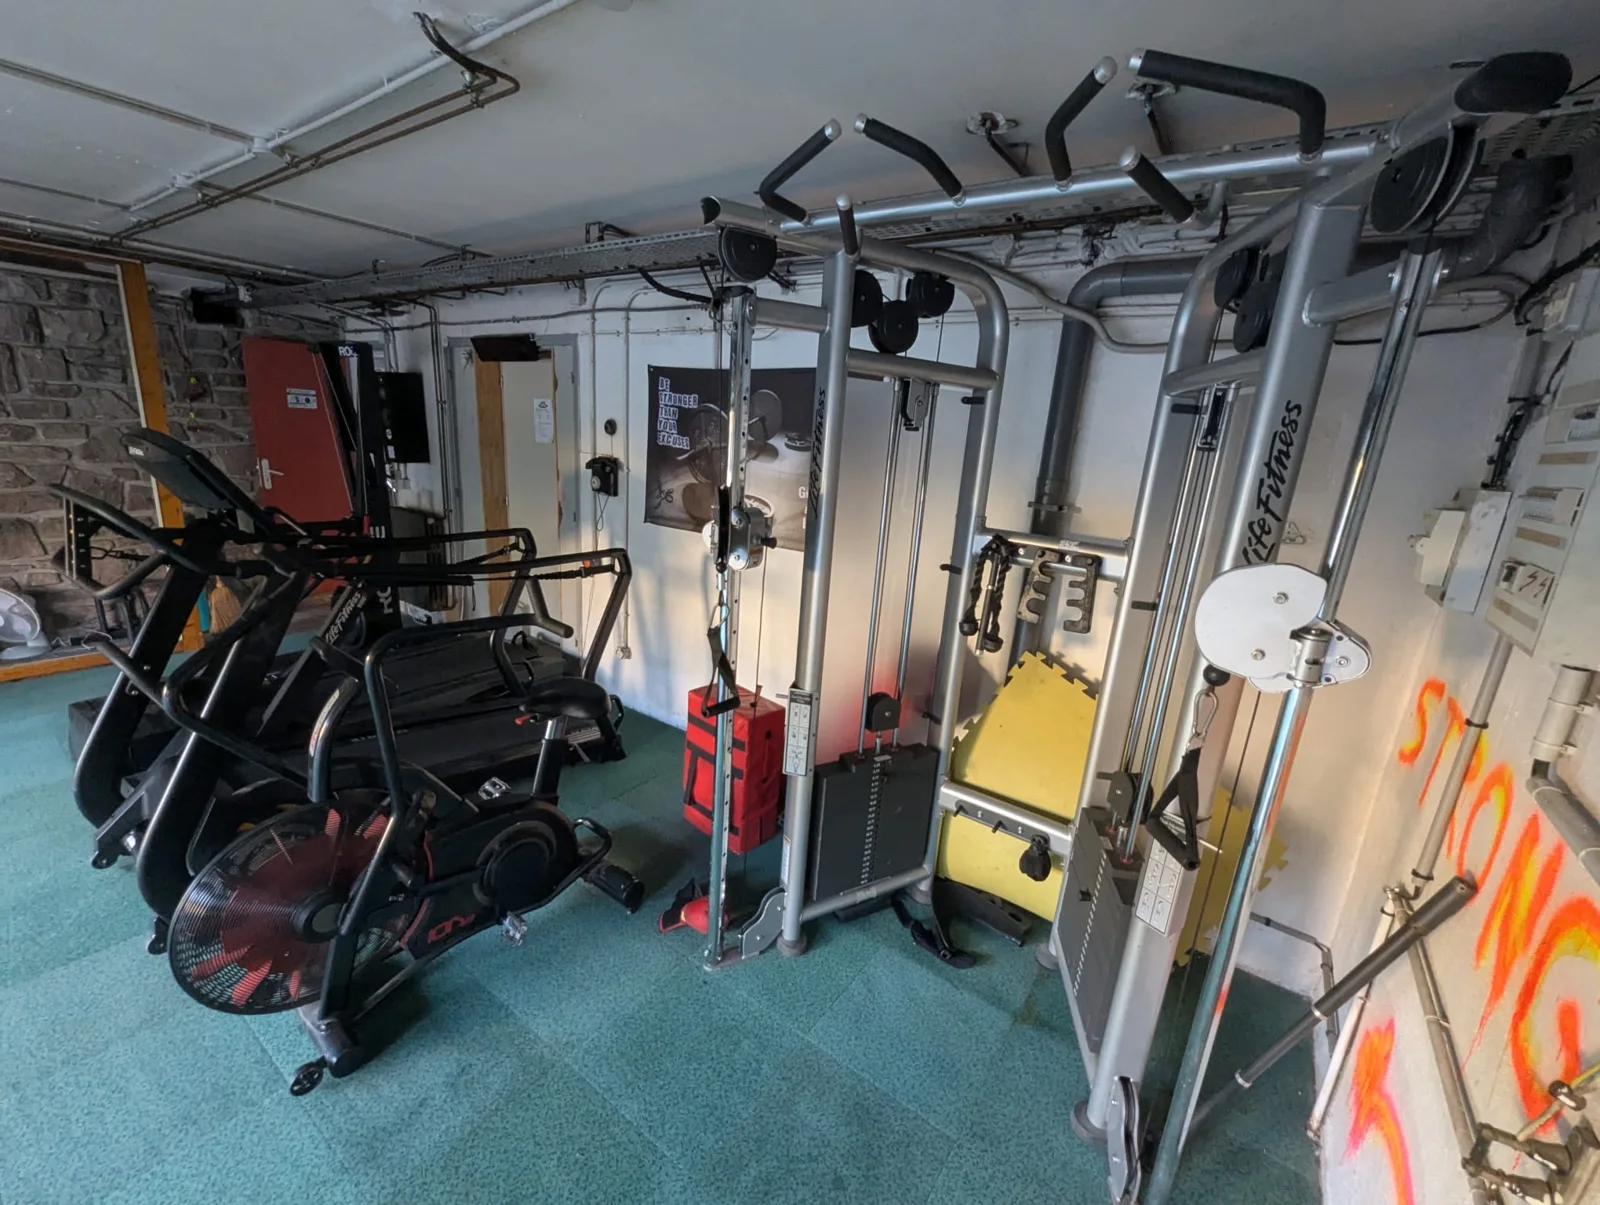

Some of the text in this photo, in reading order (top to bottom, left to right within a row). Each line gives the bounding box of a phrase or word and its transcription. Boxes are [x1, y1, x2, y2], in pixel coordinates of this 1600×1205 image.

[658, 377, 671, 390] BE
[658, 391, 699, 408] STRONGER
[658, 405, 679, 419] THAN
[657, 418, 678, 433] YOUR
[656, 433, 691, 450] EXCUSES
